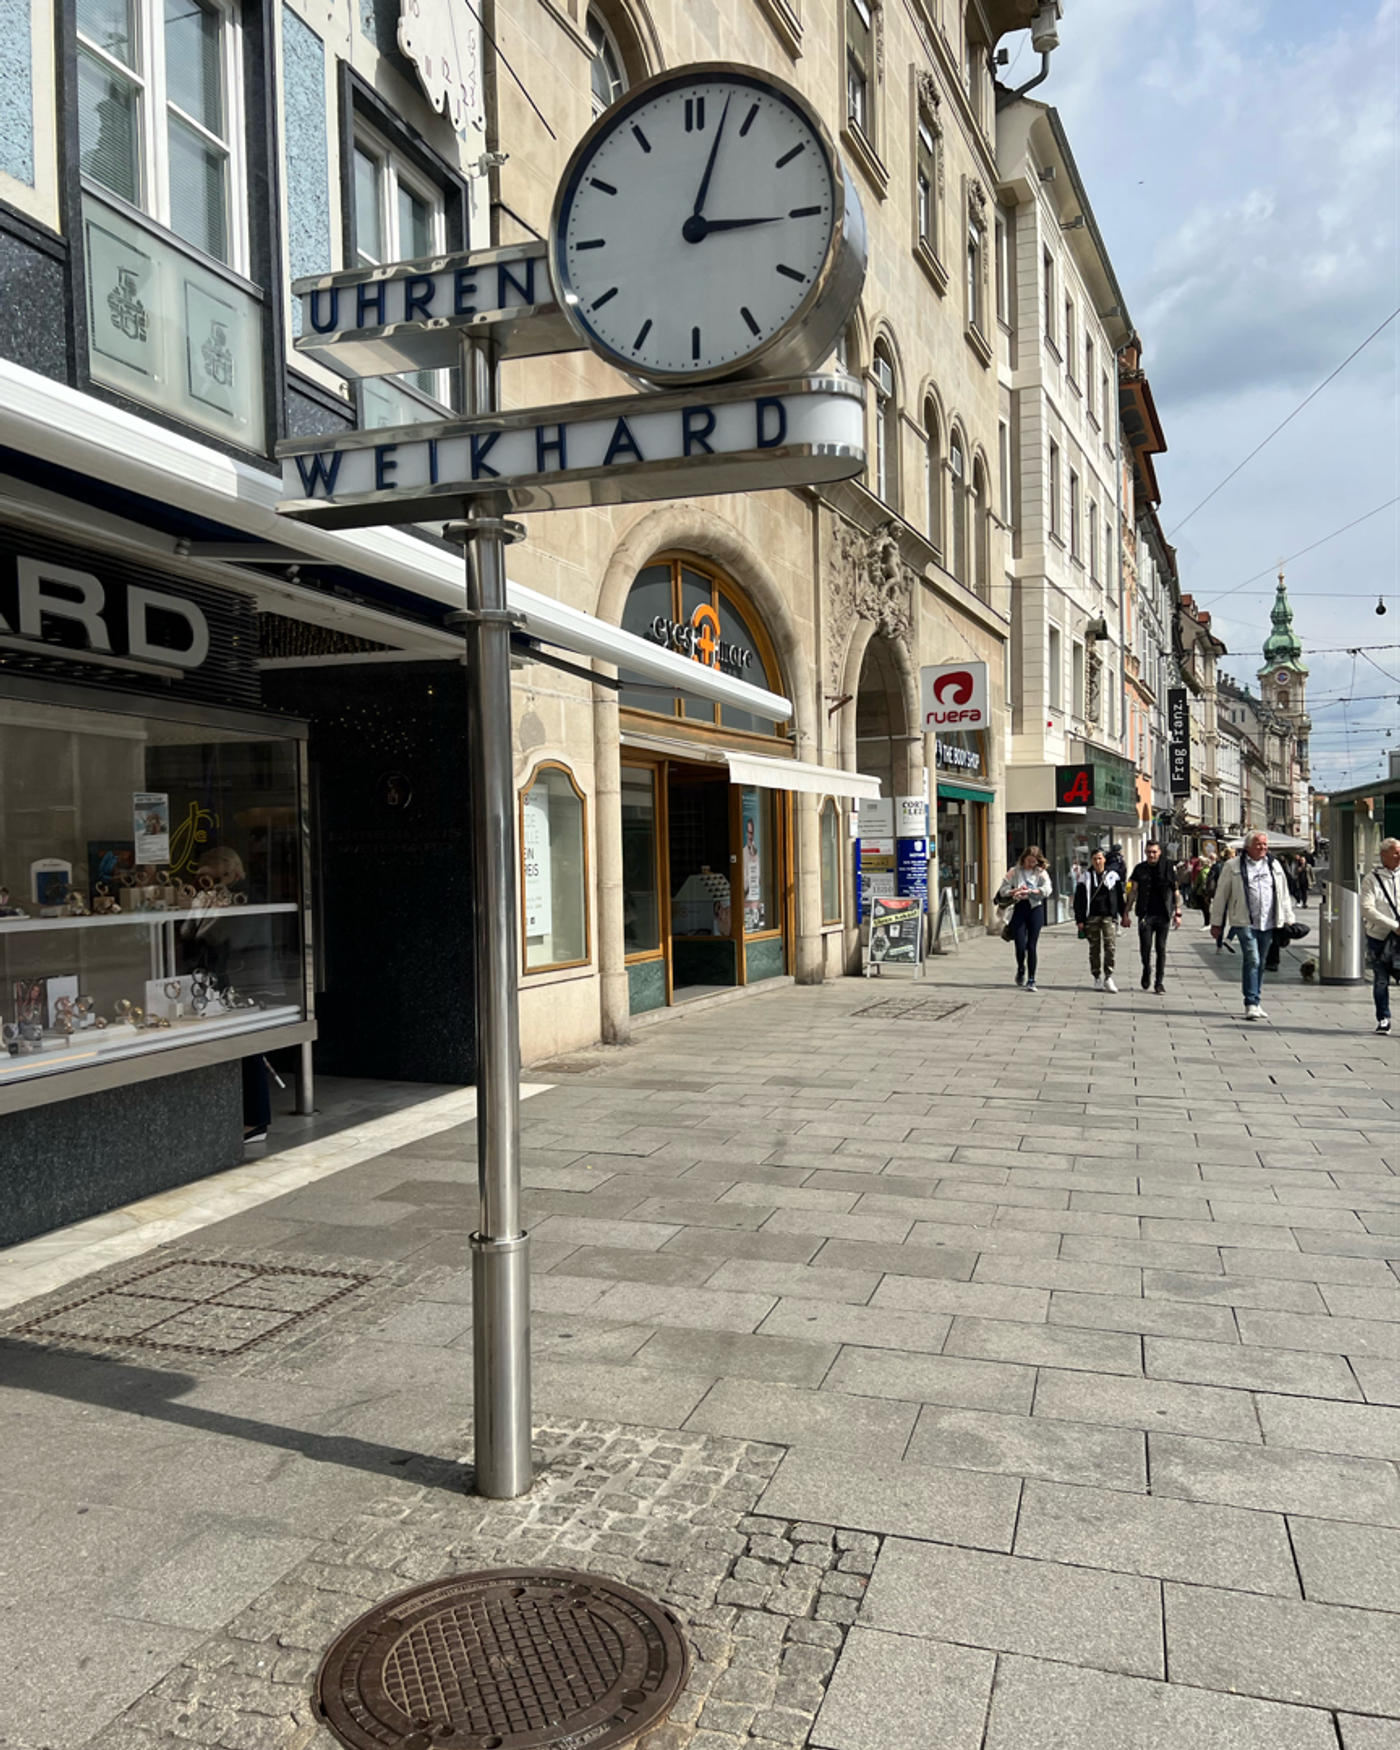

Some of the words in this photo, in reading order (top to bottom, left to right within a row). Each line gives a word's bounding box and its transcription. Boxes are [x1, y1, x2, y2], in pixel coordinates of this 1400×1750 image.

[310, 257, 535, 334] UHREN
[295, 399, 788, 498] WEIKHARD
[0, 555, 209, 668] RD
[926, 709, 981, 725] ruefa
[1172, 699, 1184, 744] Franz.
[943, 744, 953, 764] THE
[954, 747, 967, 767] BODY
[967, 752, 980, 769] SHOP
[1171, 748, 1187, 781] Frag
